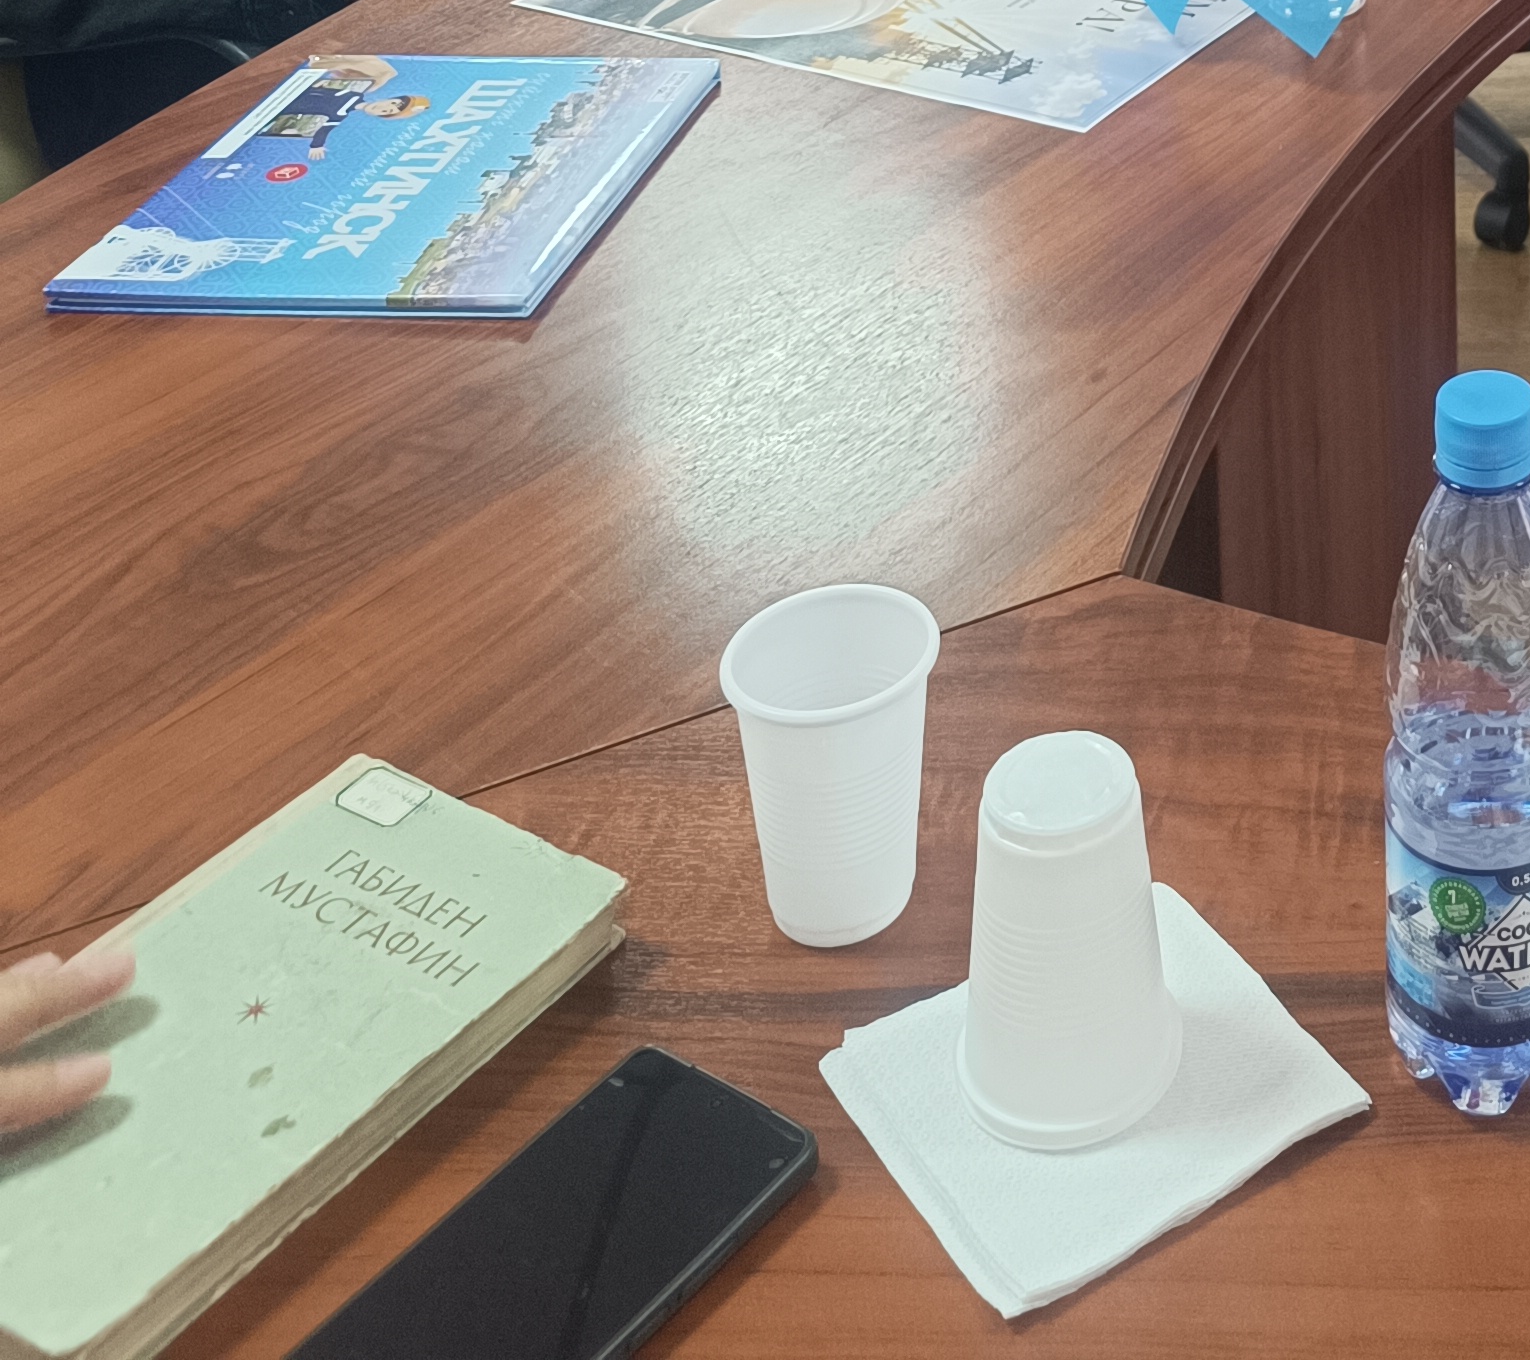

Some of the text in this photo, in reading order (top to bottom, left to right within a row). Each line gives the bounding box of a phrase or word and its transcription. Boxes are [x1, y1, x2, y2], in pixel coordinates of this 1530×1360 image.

[302, 79, 528, 260] ШАХТИНСК
[258, 871, 481, 987] МУСТАФИН
[324, 849, 488, 938] ГАБИДЕН
